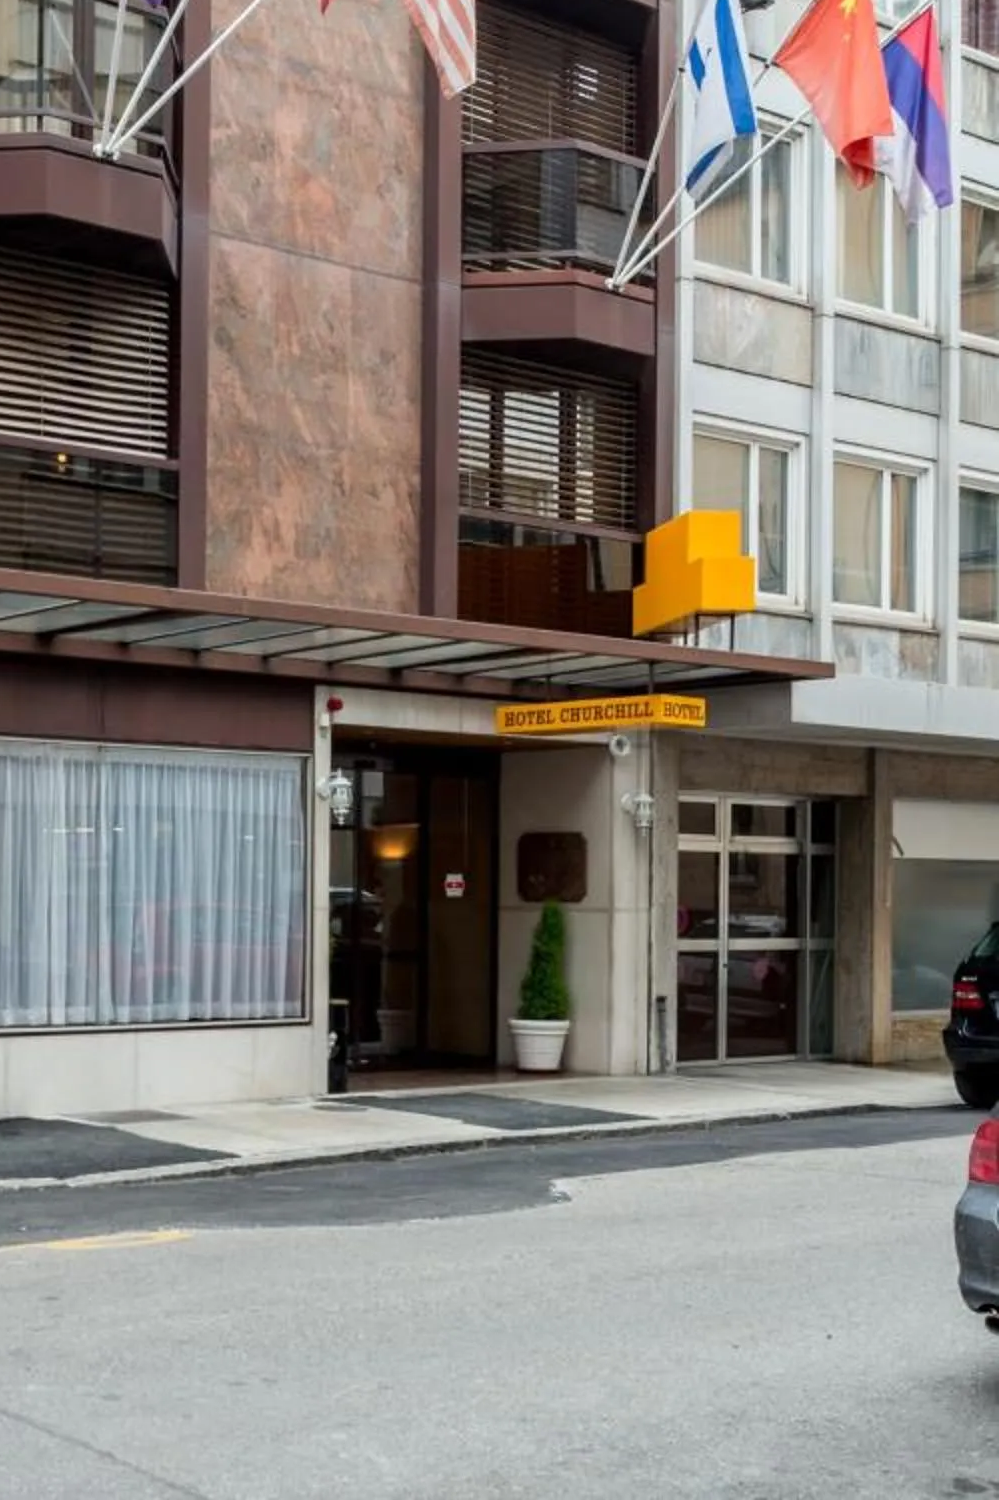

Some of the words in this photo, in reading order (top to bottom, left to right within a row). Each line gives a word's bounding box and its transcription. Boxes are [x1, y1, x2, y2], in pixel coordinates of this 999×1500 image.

[504, 707, 556, 727] HOTEL
[560, 701, 654, 723] CHURCHILL
[663, 702, 704, 720] HOTEL
